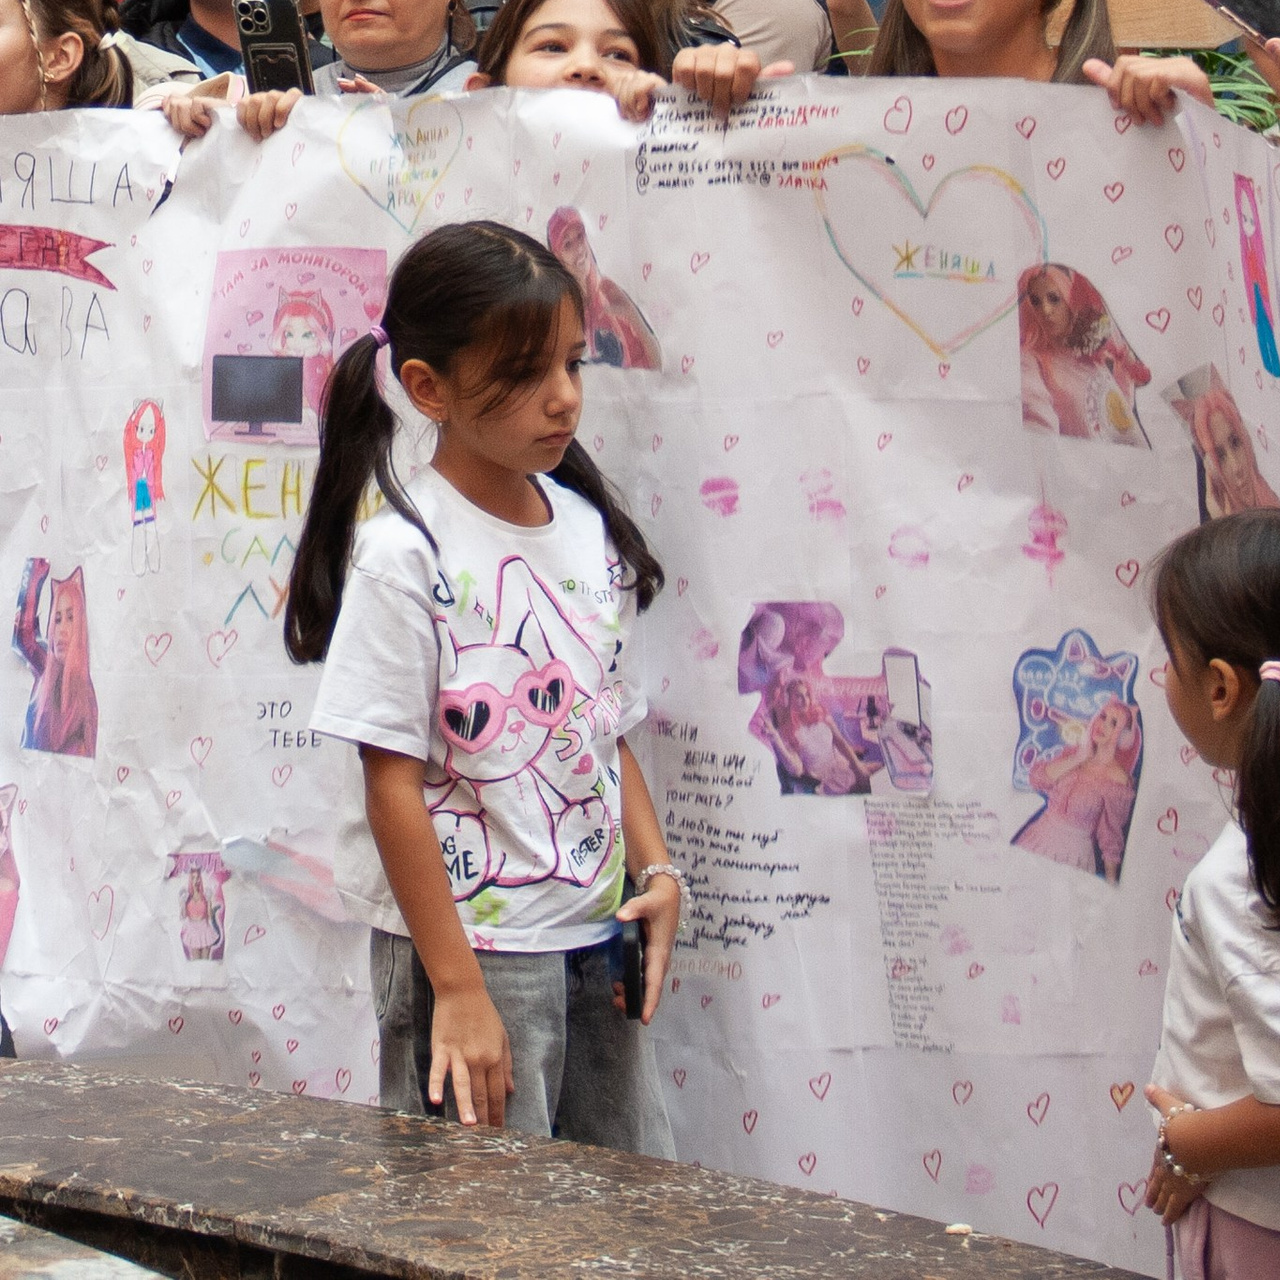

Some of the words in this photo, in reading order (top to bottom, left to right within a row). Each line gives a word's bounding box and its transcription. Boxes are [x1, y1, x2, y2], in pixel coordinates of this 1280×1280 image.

[251, 256, 270, 272] ЗА
[191, 453, 310, 521] ЖЕН
[256, 700, 293, 720] ЭТО
[269, 728, 323, 748] ТЕБЕ
[570, 827, 605, 868] FASTER
